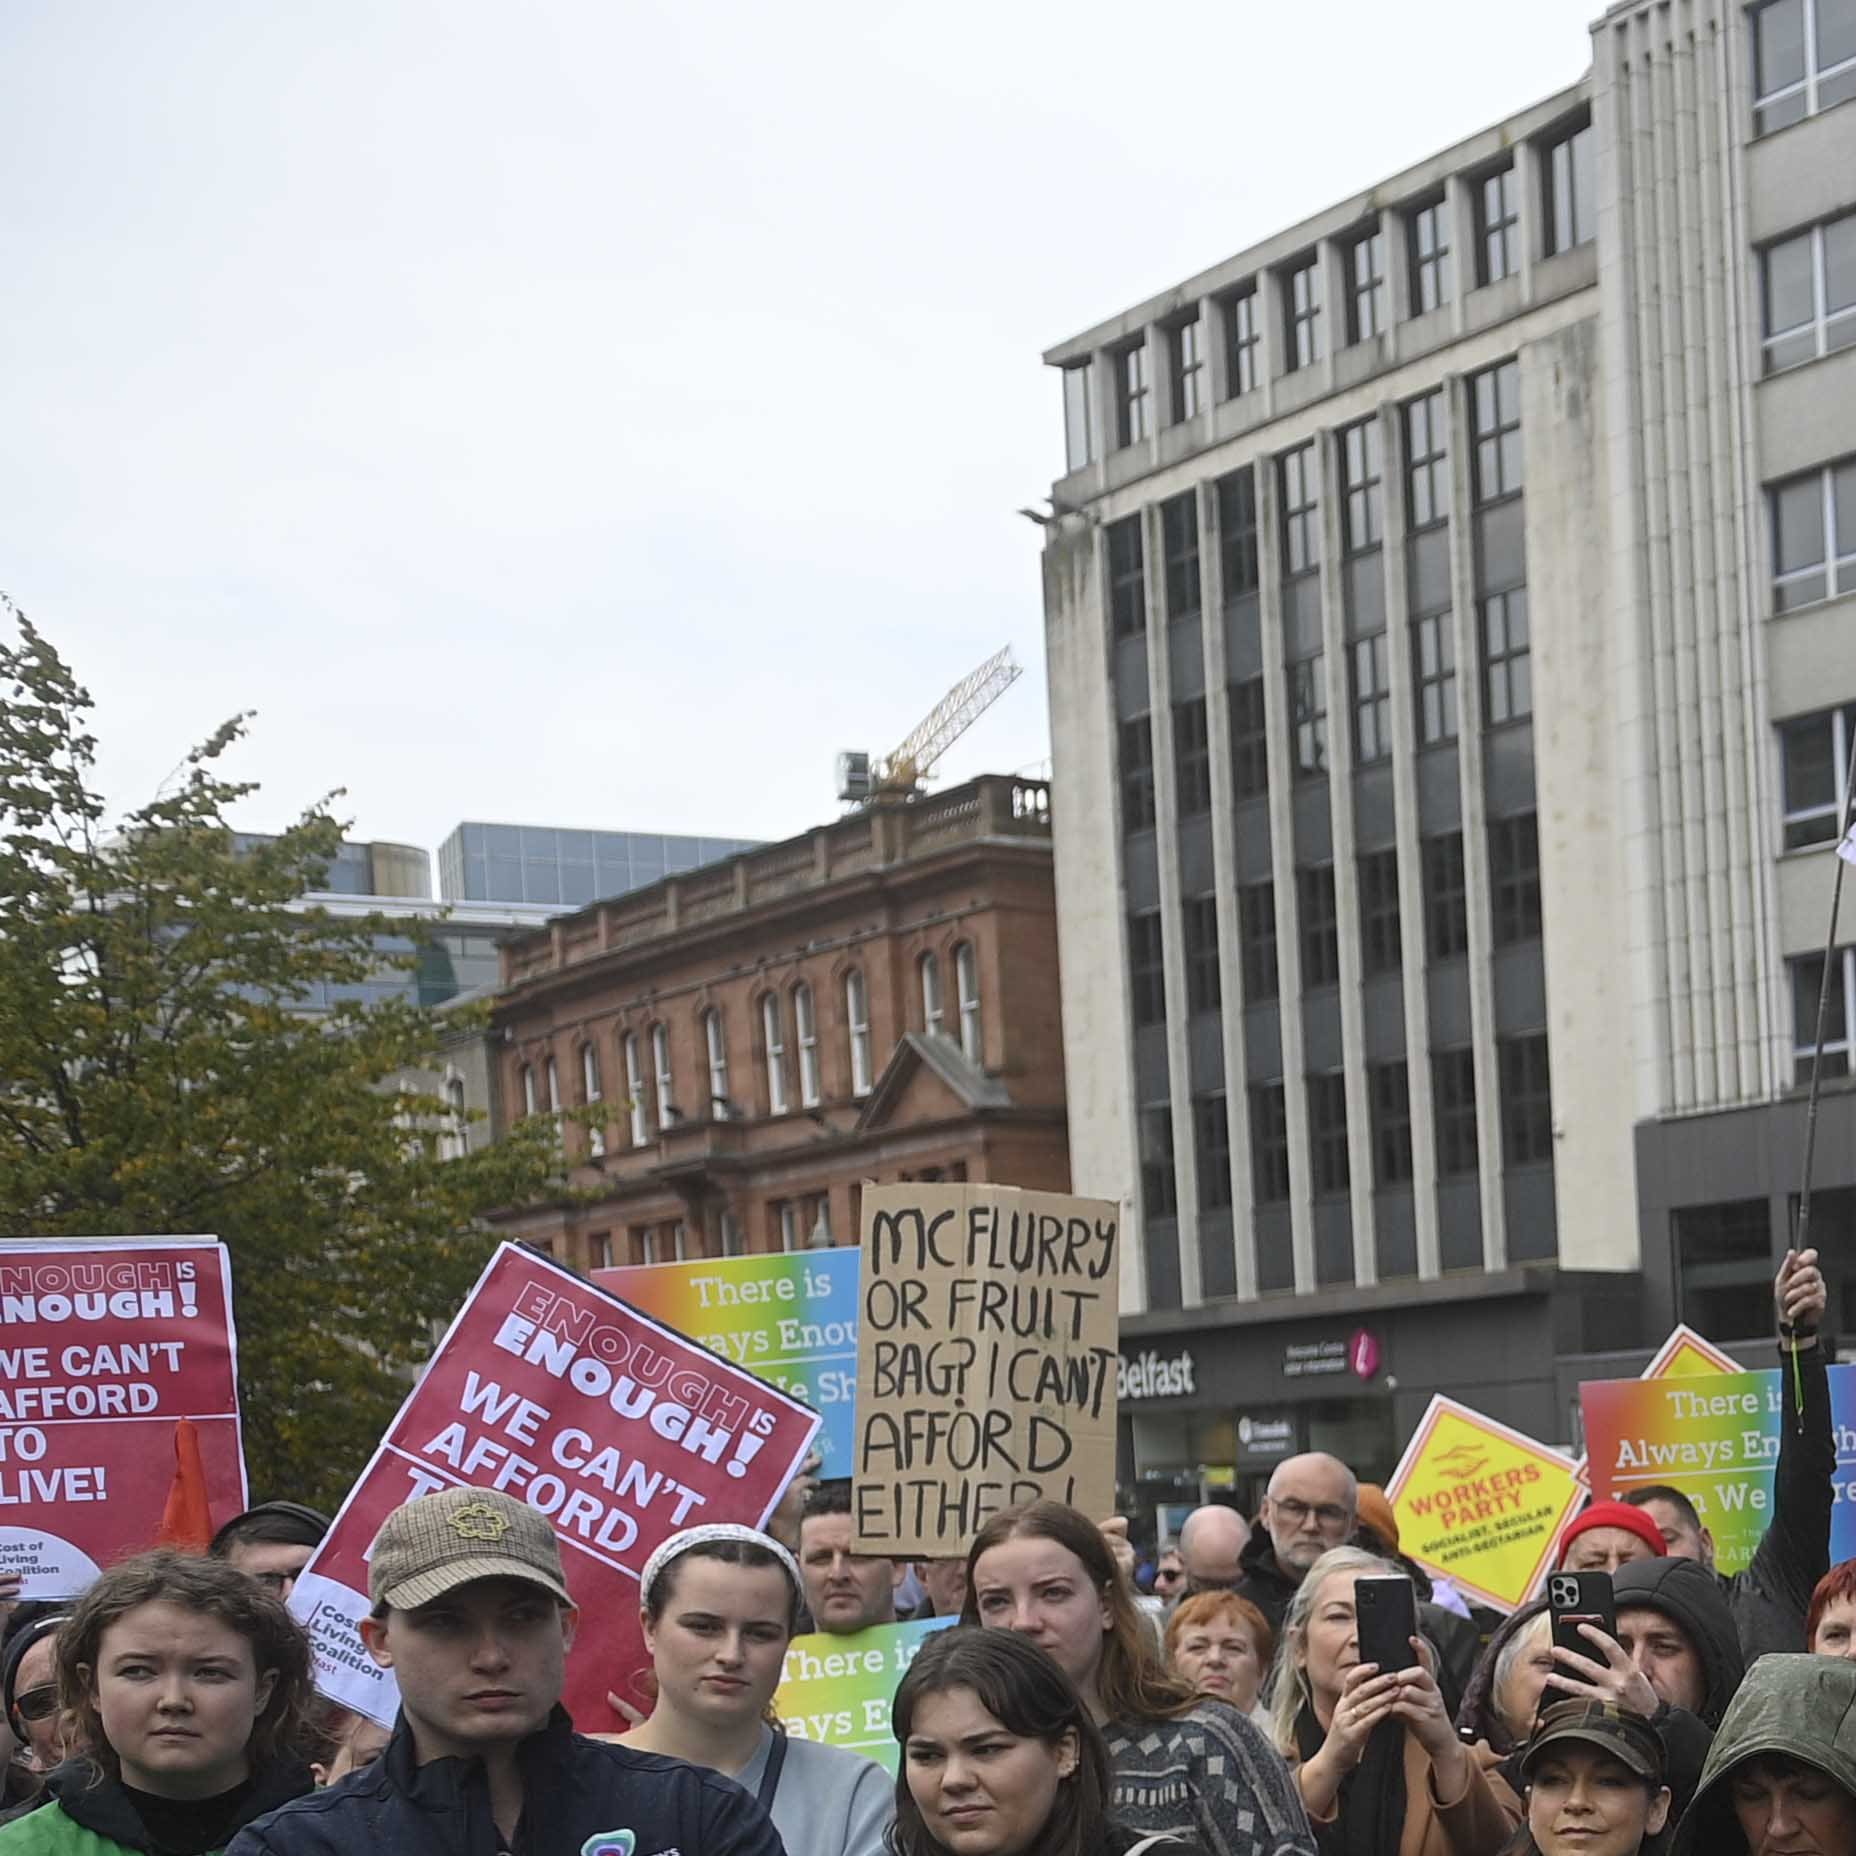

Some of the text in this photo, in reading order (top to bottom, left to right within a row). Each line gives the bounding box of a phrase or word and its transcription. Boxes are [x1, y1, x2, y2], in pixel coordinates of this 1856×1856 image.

[0, 1262, 196, 1294] NOUGH IS
[690, 1268, 832, 1309] There is
[0, 1282, 199, 1323] NOUGH!
[867, 1279, 1100, 1340] OR FRUIT
[61, 1342, 184, 1376] CAN'T
[513, 1281, 778, 1436] ENOUGH IS
[874, 1337, 1118, 1419] BAG? I CAN'T
[1117, 1349, 1195, 1400] Belfast
[493, 1315, 768, 1479] ENOUGH!
[1666, 1389, 1760, 1419] There
[460, 1370, 707, 1526] WE CAN'T
[862, 1409, 1072, 1473] AFFORD
[1615, 1439, 1735, 1469] Always
[0, 1467, 108, 1505] LIVE!
[422, 1423, 640, 1554] AFFORD
[1409, 1464, 1542, 1518] WORKERS
[1714, 1483, 1768, 1514] We
[1440, 1490, 1523, 1531] PARTY
[779, 1650, 885, 1684] There
